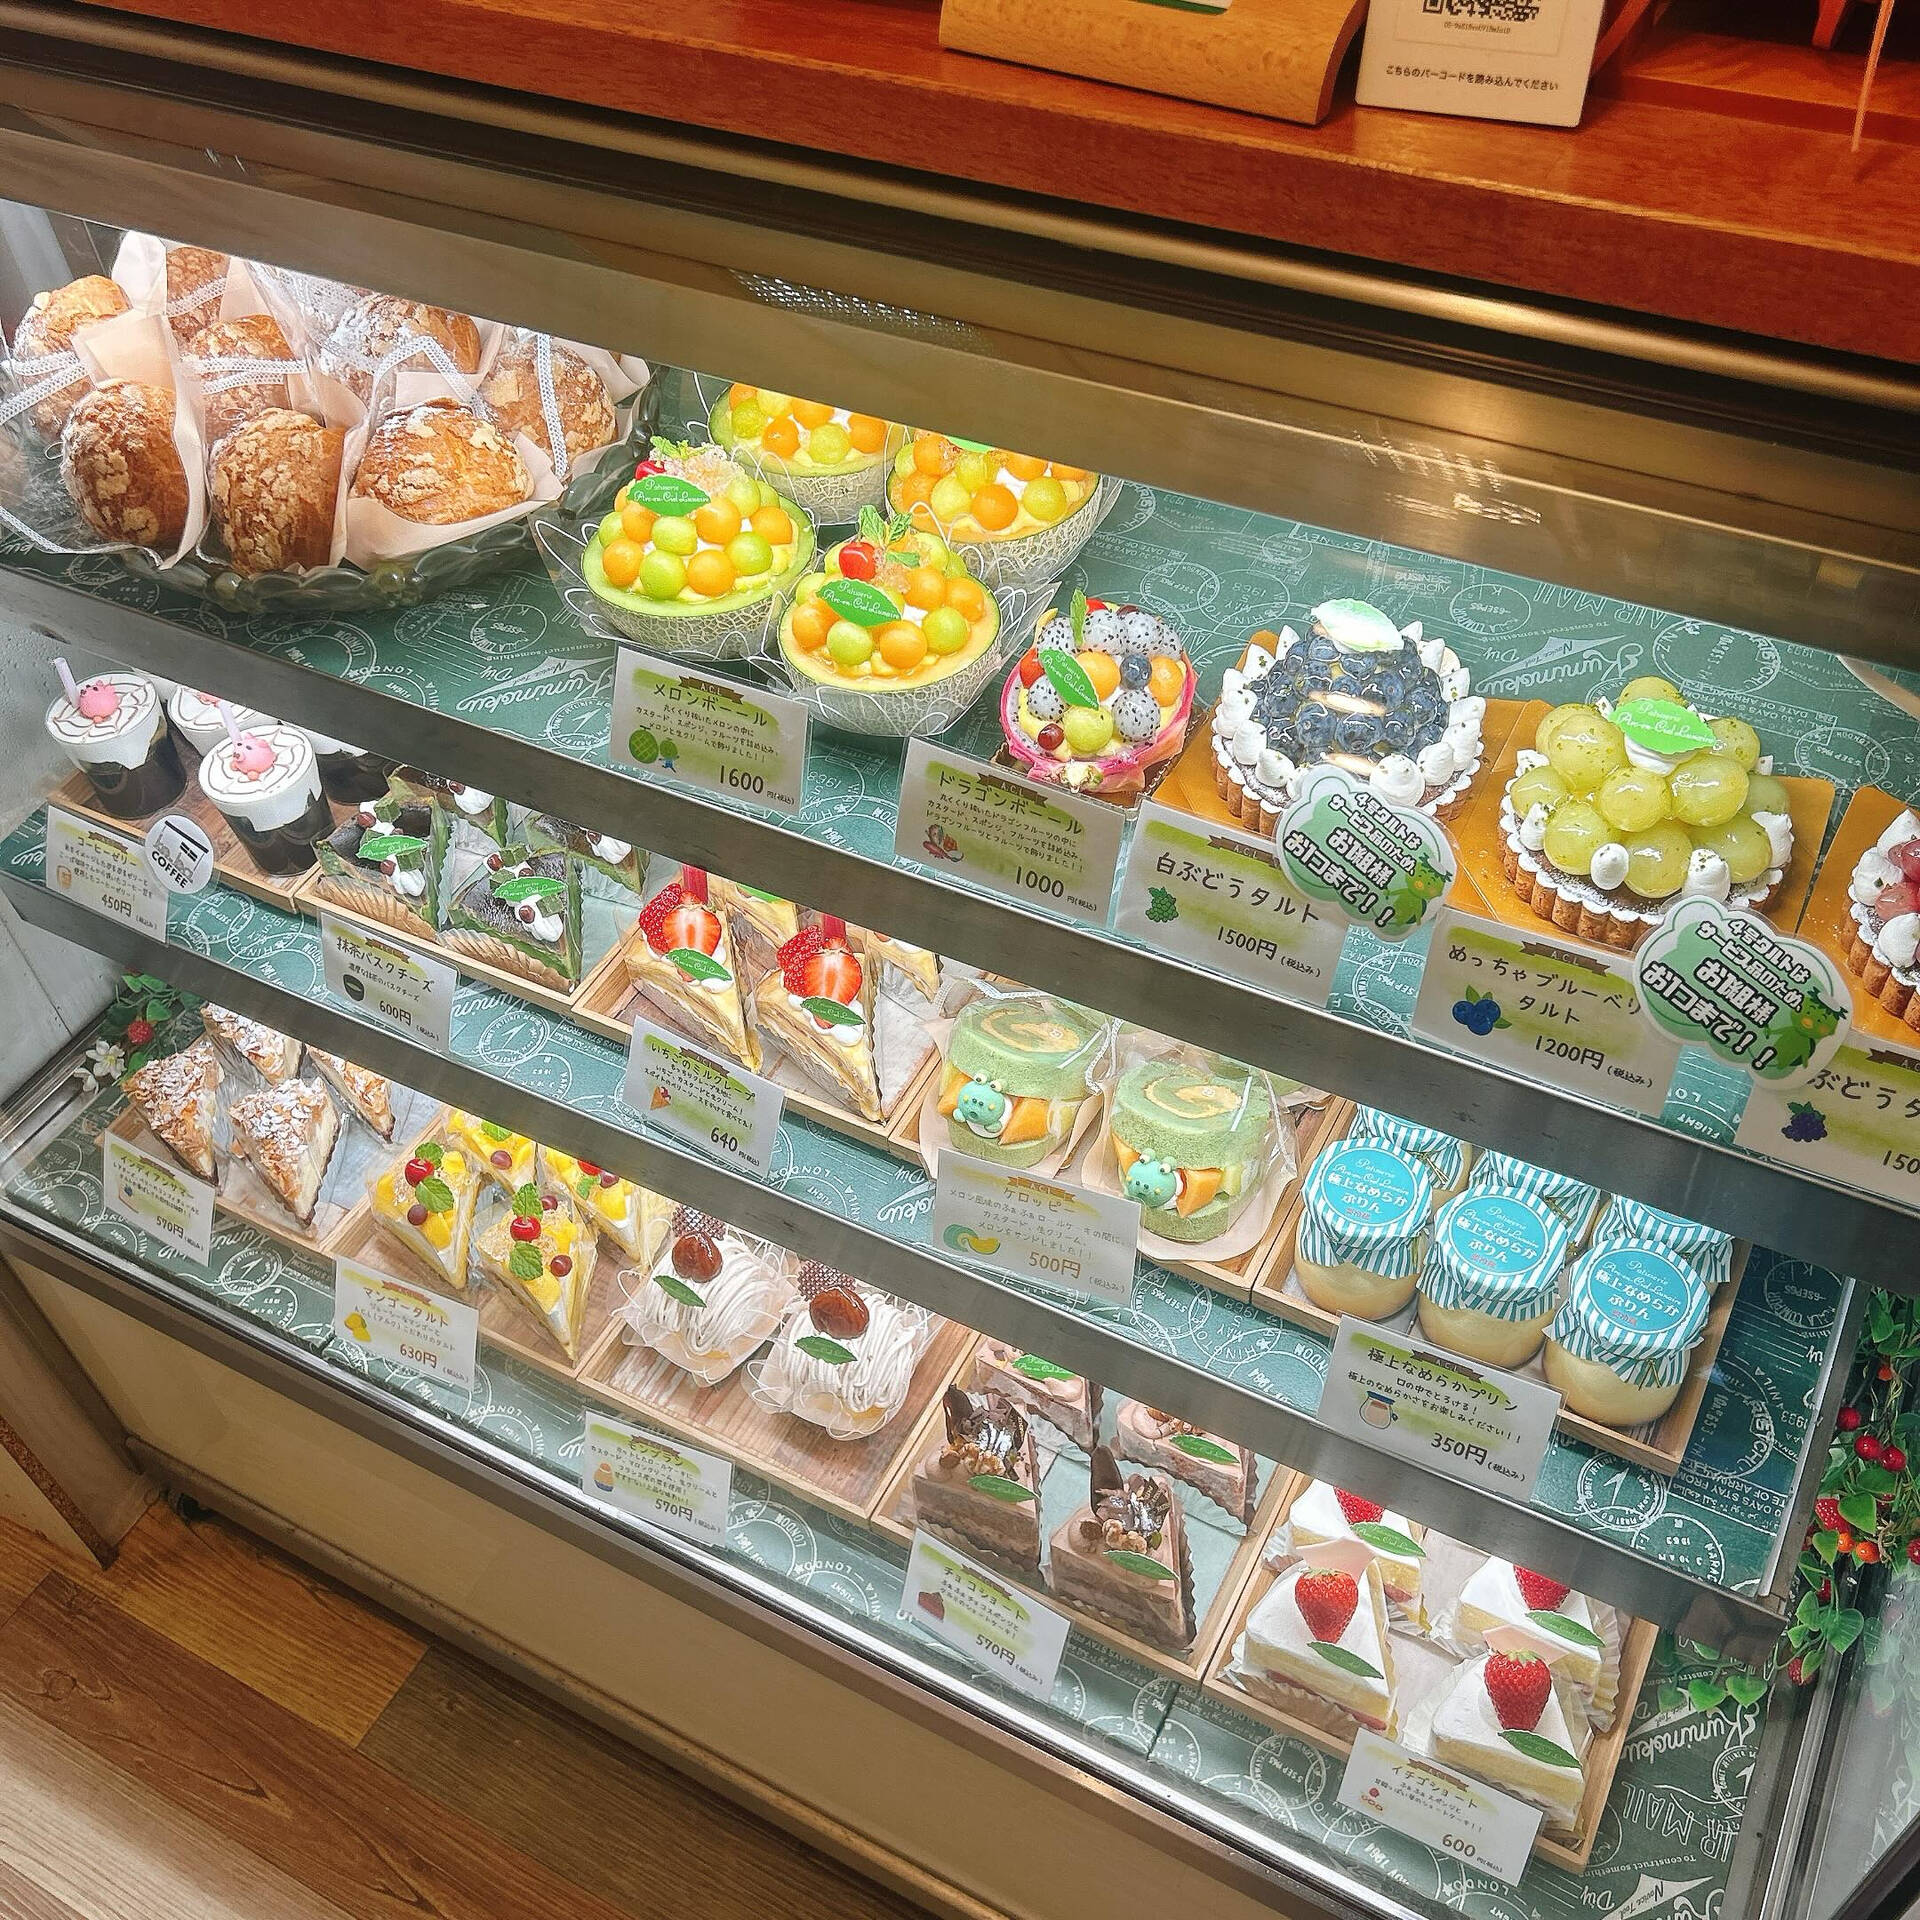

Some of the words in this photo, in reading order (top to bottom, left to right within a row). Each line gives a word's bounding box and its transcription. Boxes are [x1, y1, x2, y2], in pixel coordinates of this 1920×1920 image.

[1386, 64, 1559, 91] こちらのバーコードを読み込んでください
[719, 765, 764, 795] 1600
[1328, 794, 1418, 877] サービス品のため、
[1354, 792, 1423, 850] 4号タルトは
[77, 836, 138, 867] コーヒーゼリー
[1326, 827, 1397, 890] お1組様
[151, 850, 188, 889] COFFEE
[1015, 866, 1065, 899] 1000
[1156, 851, 1320, 924] 白ぶどうタルト
[101, 894, 132, 917] 450円
[1217, 926, 1278, 961] 1500円
[1727, 918, 1812, 985] 4号タルトは
[336, 936, 435, 993] 抹茶バスクチーズ
[1695, 920, 1805, 1014] サービス品のため、
[1693, 957, 1781, 1028] お1組様
[379, 1000, 413, 1027] 600円
[1518, 995, 1581, 1026] タルト
[1535, 1035, 1606, 1072] 1200円
[651, 1042, 756, 1101] いちごのミルクレープ
[710, 1126, 738, 1152] 640
[1003, 1187, 1077, 1214] ケロッピー
[1327, 1171, 1408, 1208] 極上なめらか
[1341, 1192, 1384, 1215] ぷりん
[1456, 1216, 1538, 1260] 極上なめらか
[1468, 1240, 1509, 1264] ぷりん
[1028, 1251, 1081, 1280] 500円
[363, 1287, 449, 1329] マンゴータルト
[1594, 1268, 1680, 1317] 極上なめらか
[1607, 1294, 1650, 1321] ぷりん
[400, 1343, 438, 1369] 630円
[1367, 1347, 1518, 1412] 極上なめらかプリン
[1396, 1377, 1478, 1416] 口の中でとろける！
[628, 1440, 683, 1467] モンブラン
[1430, 1432, 1489, 1467] 350円
[654, 1498, 693, 1522] 570円
[943, 1566, 1025, 1621] チョコショート
[975, 1633, 1017, 1666] 570円
[1391, 1765, 1479, 1809] イチゴショート
[1442, 1833, 1476, 1858] 600
